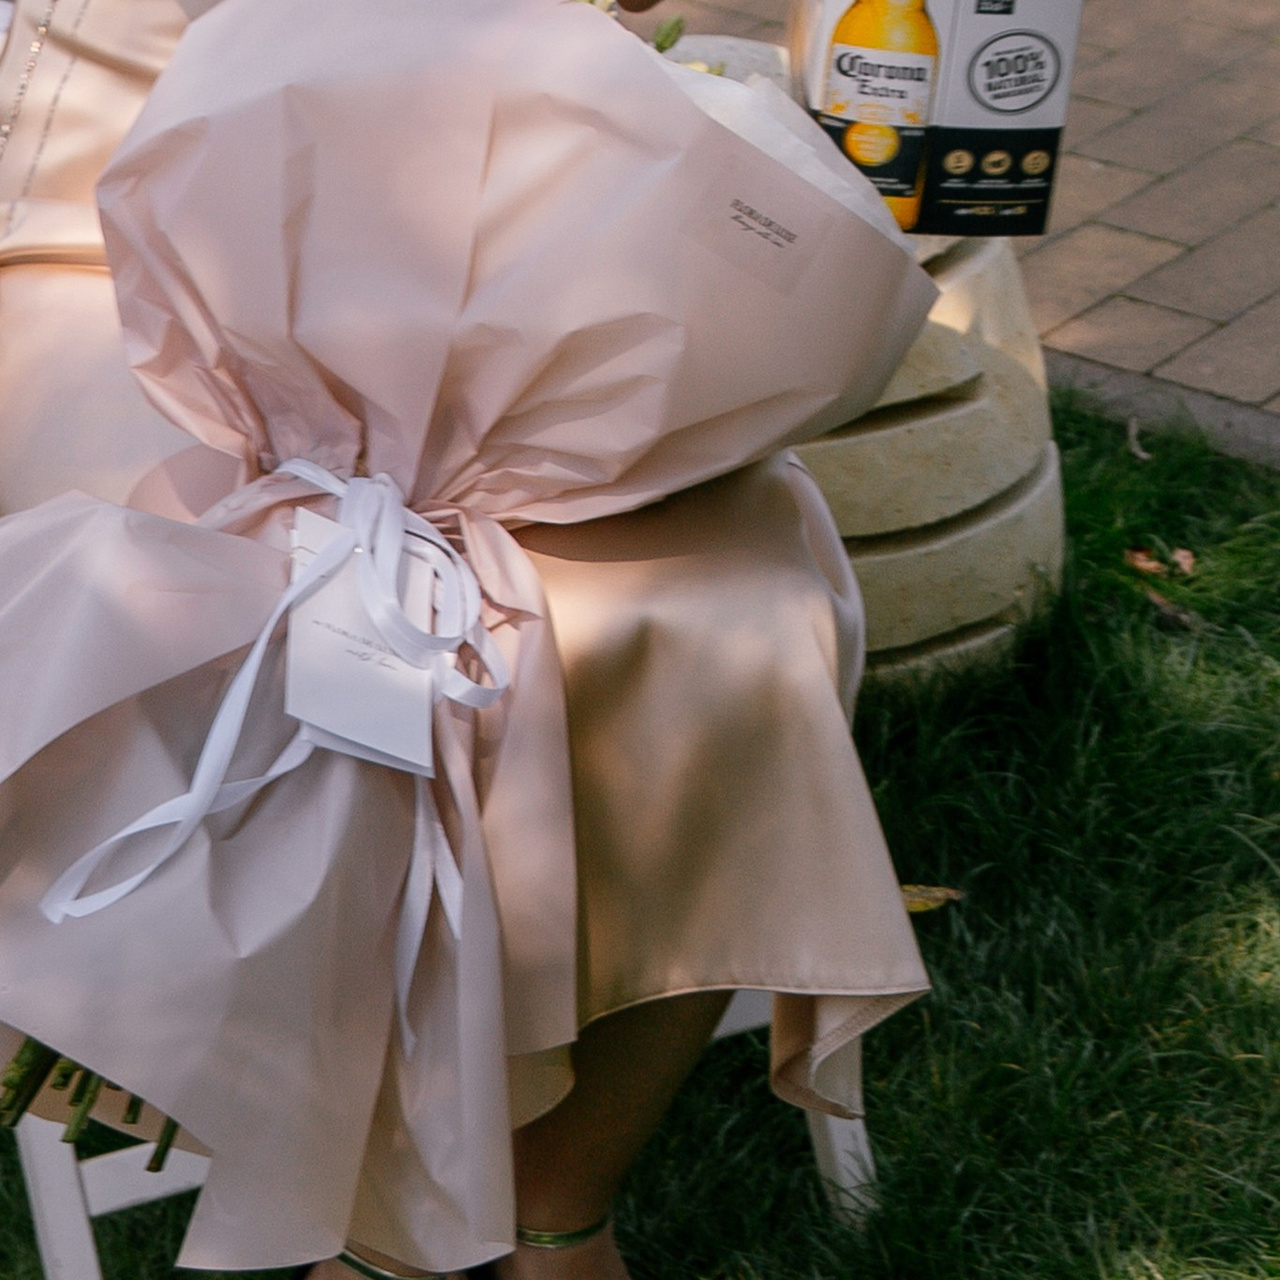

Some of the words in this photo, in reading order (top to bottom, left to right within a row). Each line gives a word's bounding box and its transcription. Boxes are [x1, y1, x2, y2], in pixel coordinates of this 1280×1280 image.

[836, 52, 929, 82] Corona
[982, 50, 1047, 81] 100%
[853, 77, 908, 99] Extra
